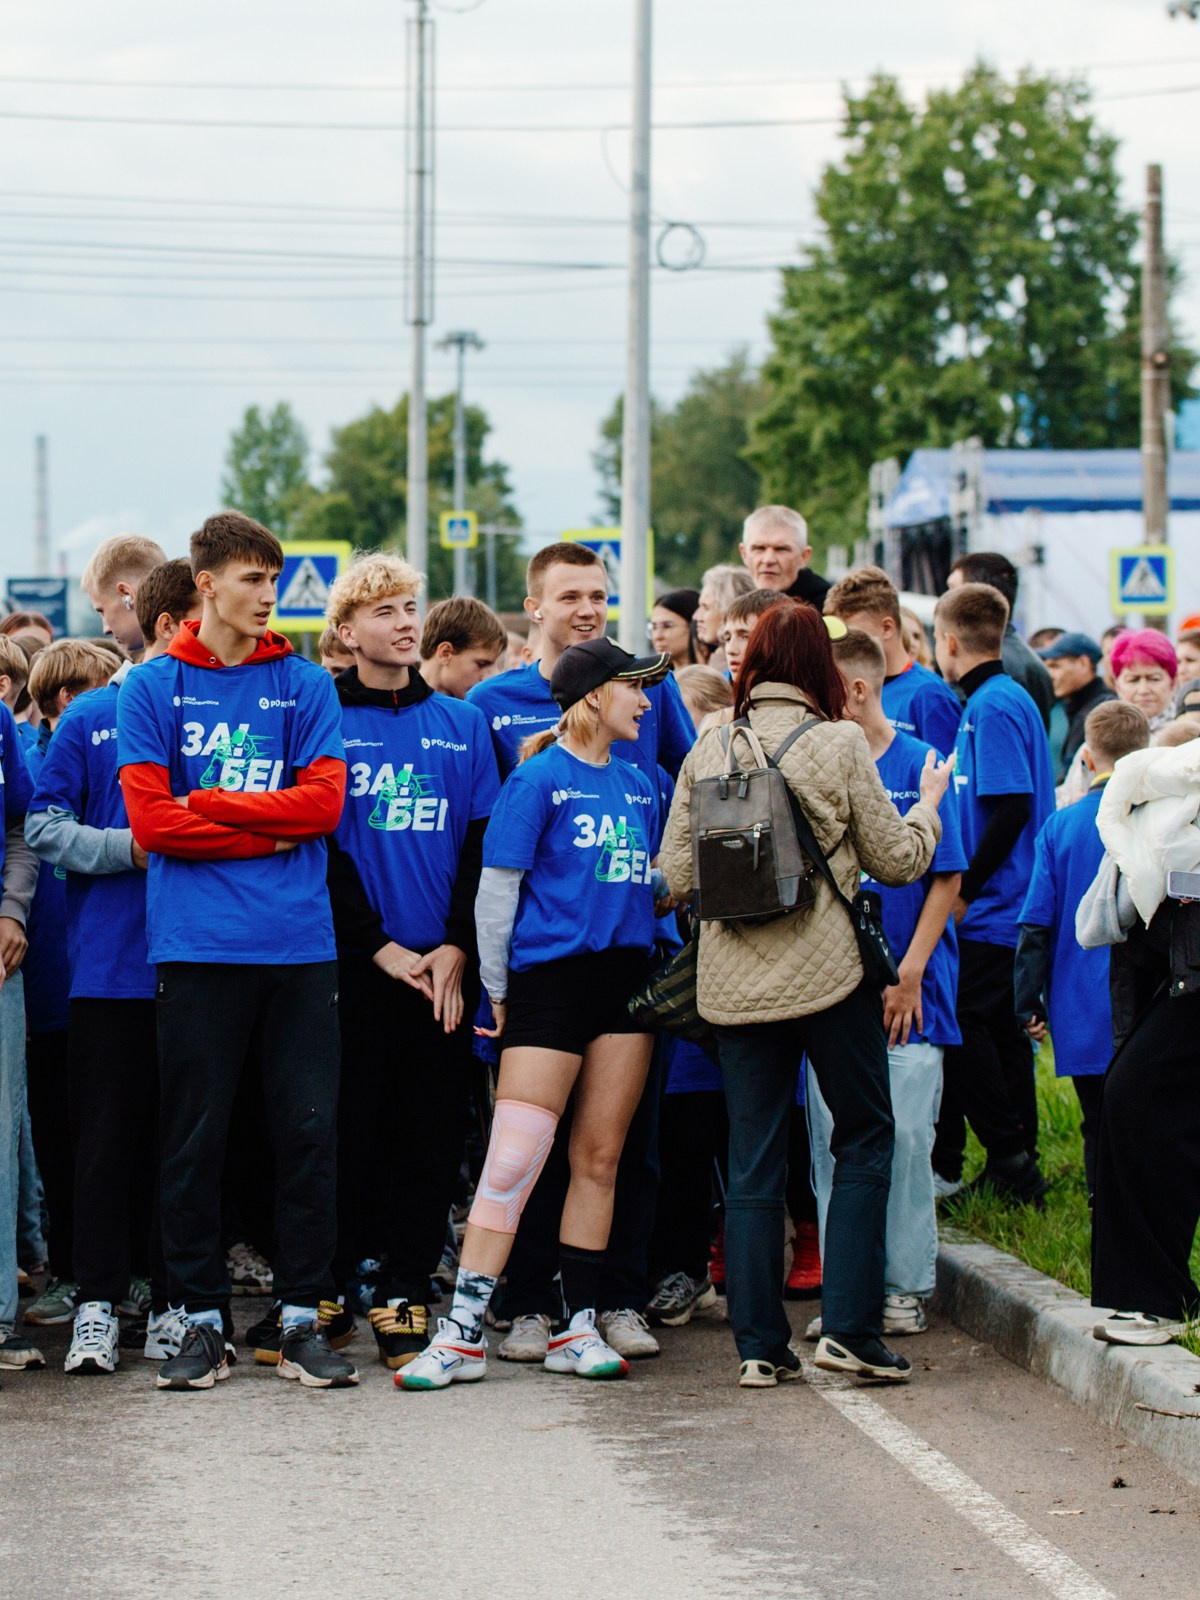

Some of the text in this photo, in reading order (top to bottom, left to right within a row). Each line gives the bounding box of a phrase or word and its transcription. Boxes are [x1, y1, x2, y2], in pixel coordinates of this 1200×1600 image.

[180, 721, 250, 757] ЗА!
[349, 762, 414, 798] ЗА!
[572, 813, 627, 849] ЗА!
